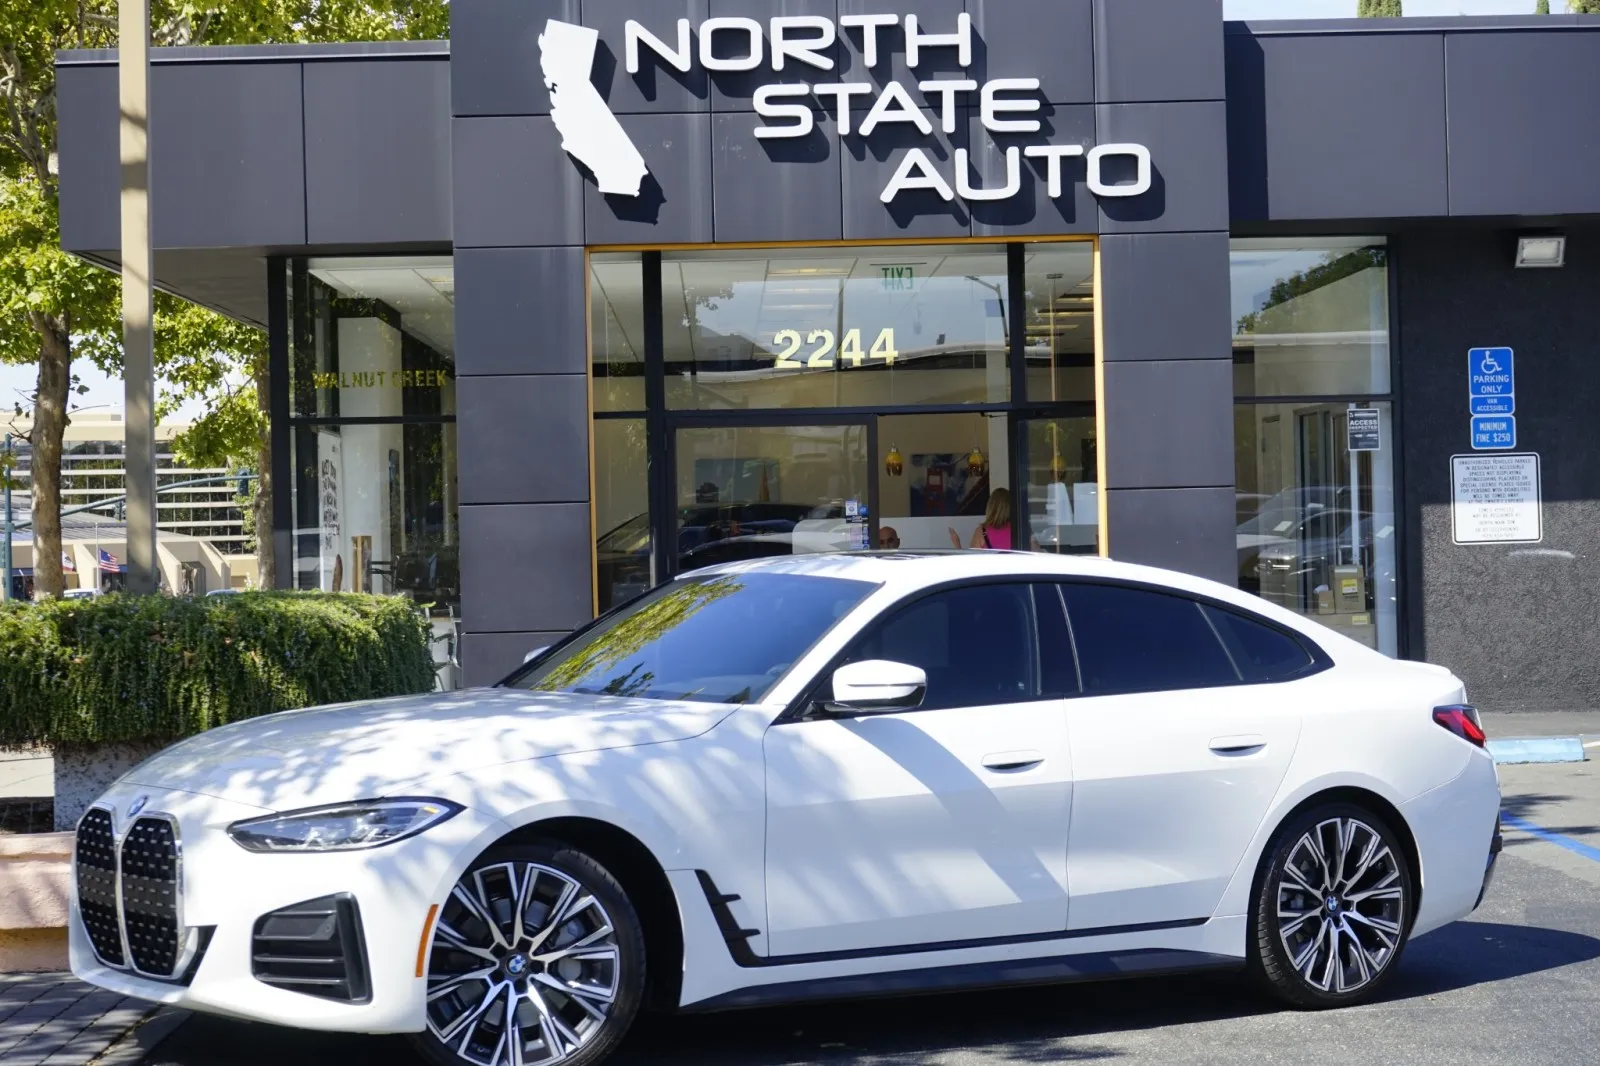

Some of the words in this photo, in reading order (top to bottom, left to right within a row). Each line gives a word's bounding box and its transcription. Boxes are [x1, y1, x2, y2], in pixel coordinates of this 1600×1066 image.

[624, 12, 971, 73] NORTH
[753, 78, 1040, 138] STATE
[880, 143, 1151, 203] AUTO
[773, 328, 898, 368] 2244
[312, 371, 387, 389] WALNUT
[392, 370, 446, 387] CREEK
[1474, 374, 1509, 383] PARKING
[1481, 385, 1502, 393] ONLY
[1480, 422, 1506, 431] MINIMUM
[1476, 434, 1490, 442] FINE
[1493, 433, 1510, 442] $250
